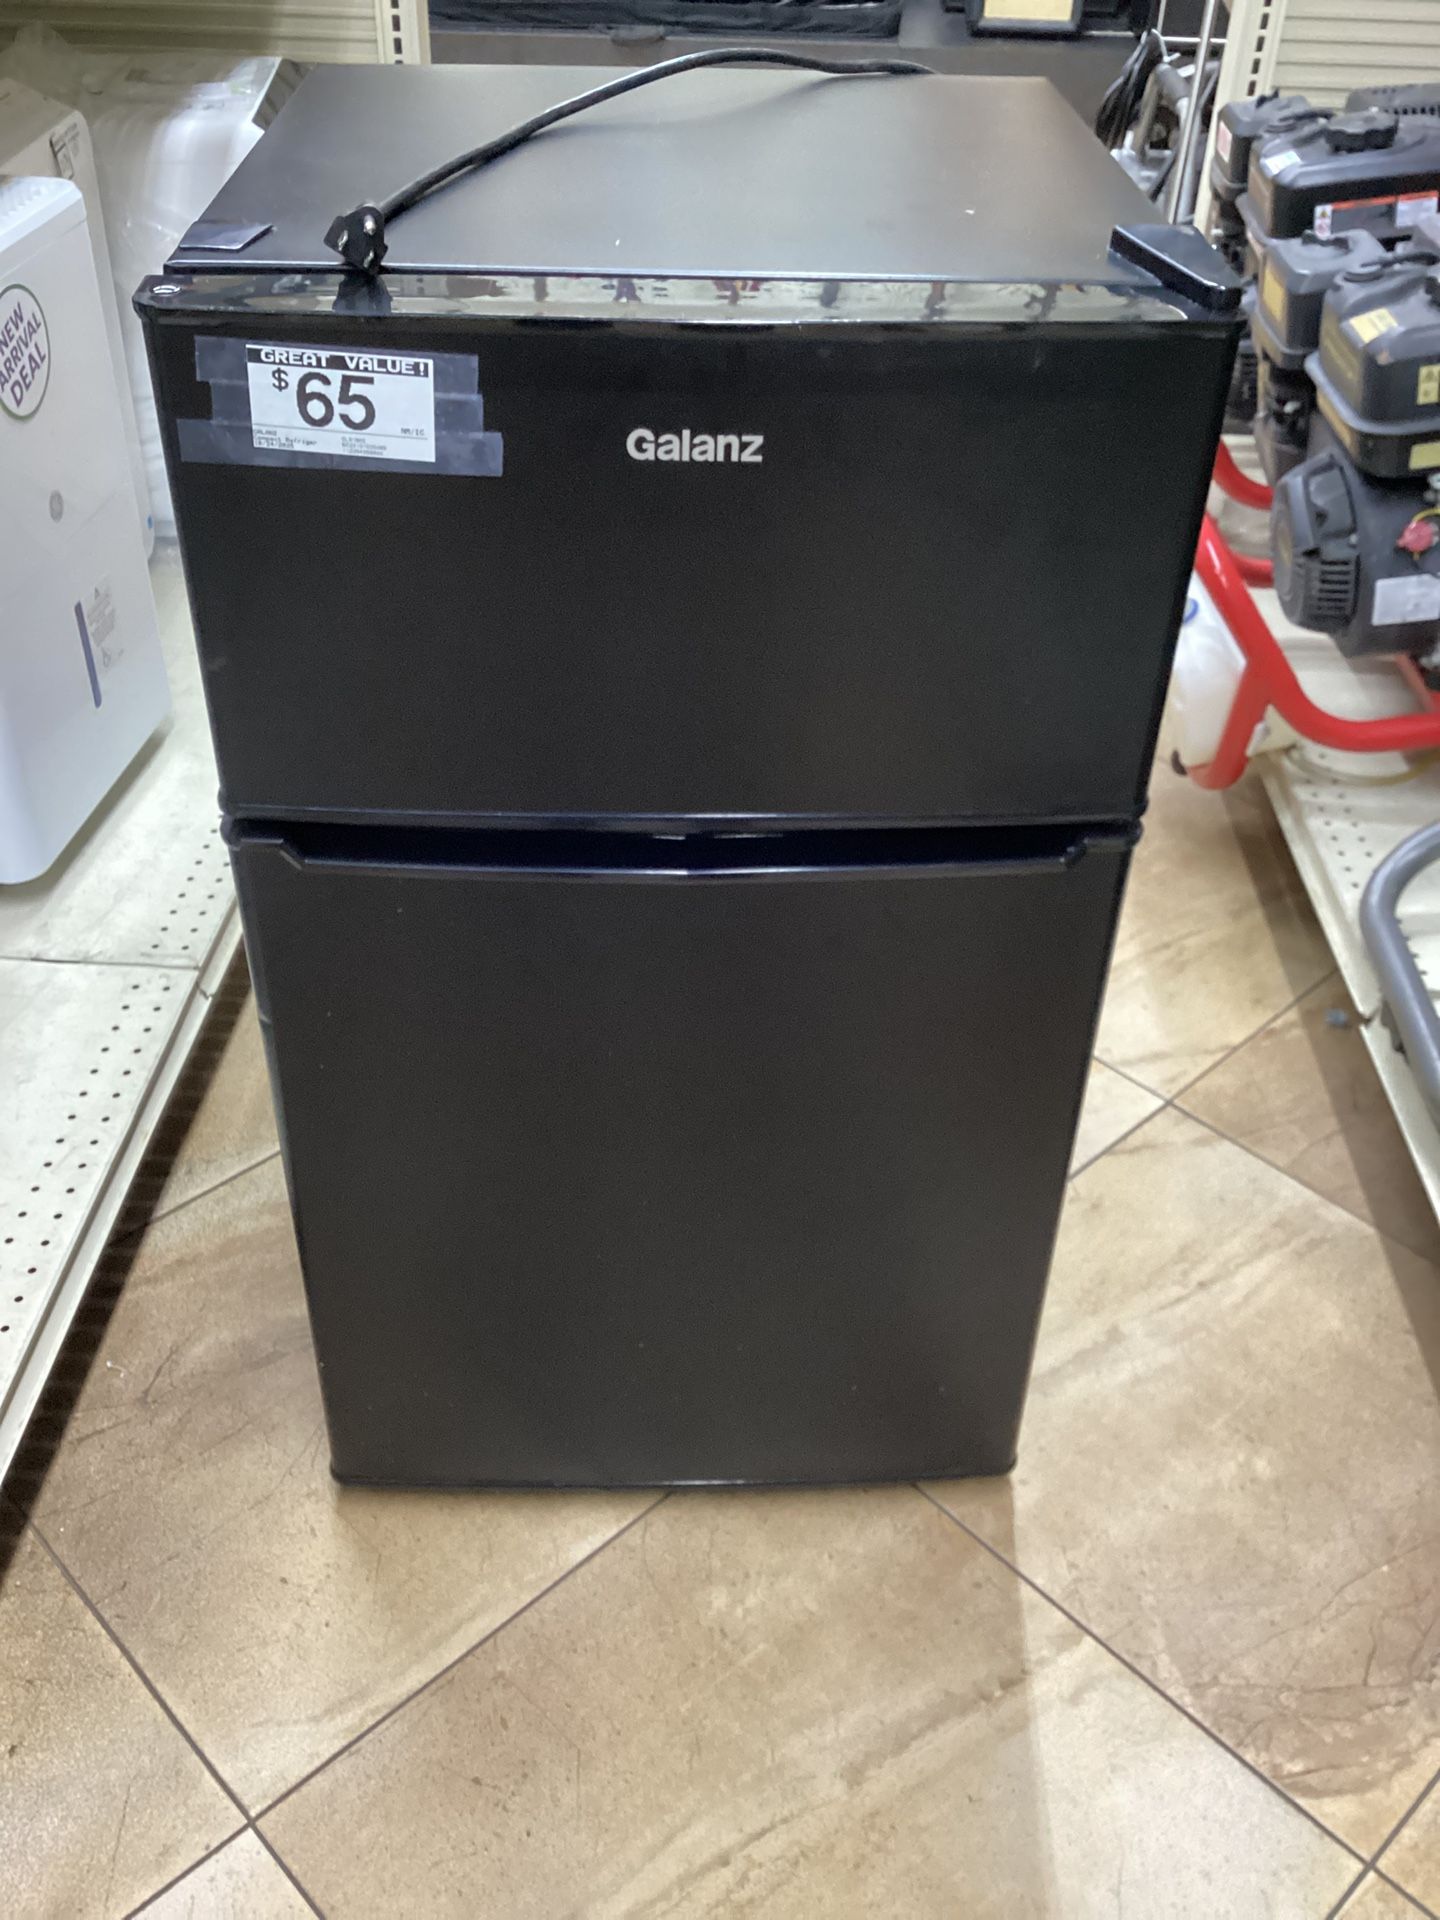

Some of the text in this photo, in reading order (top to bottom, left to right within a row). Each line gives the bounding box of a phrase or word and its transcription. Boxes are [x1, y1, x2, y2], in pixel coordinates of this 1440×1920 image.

[0, 301, 24, 356] NEW
[0, 312, 42, 393] ARRIVAL
[10, 341, 47, 408] DEAL
[260, 349, 425, 376] GREAT VALUE!
[626, 428, 764, 462] Galanz
